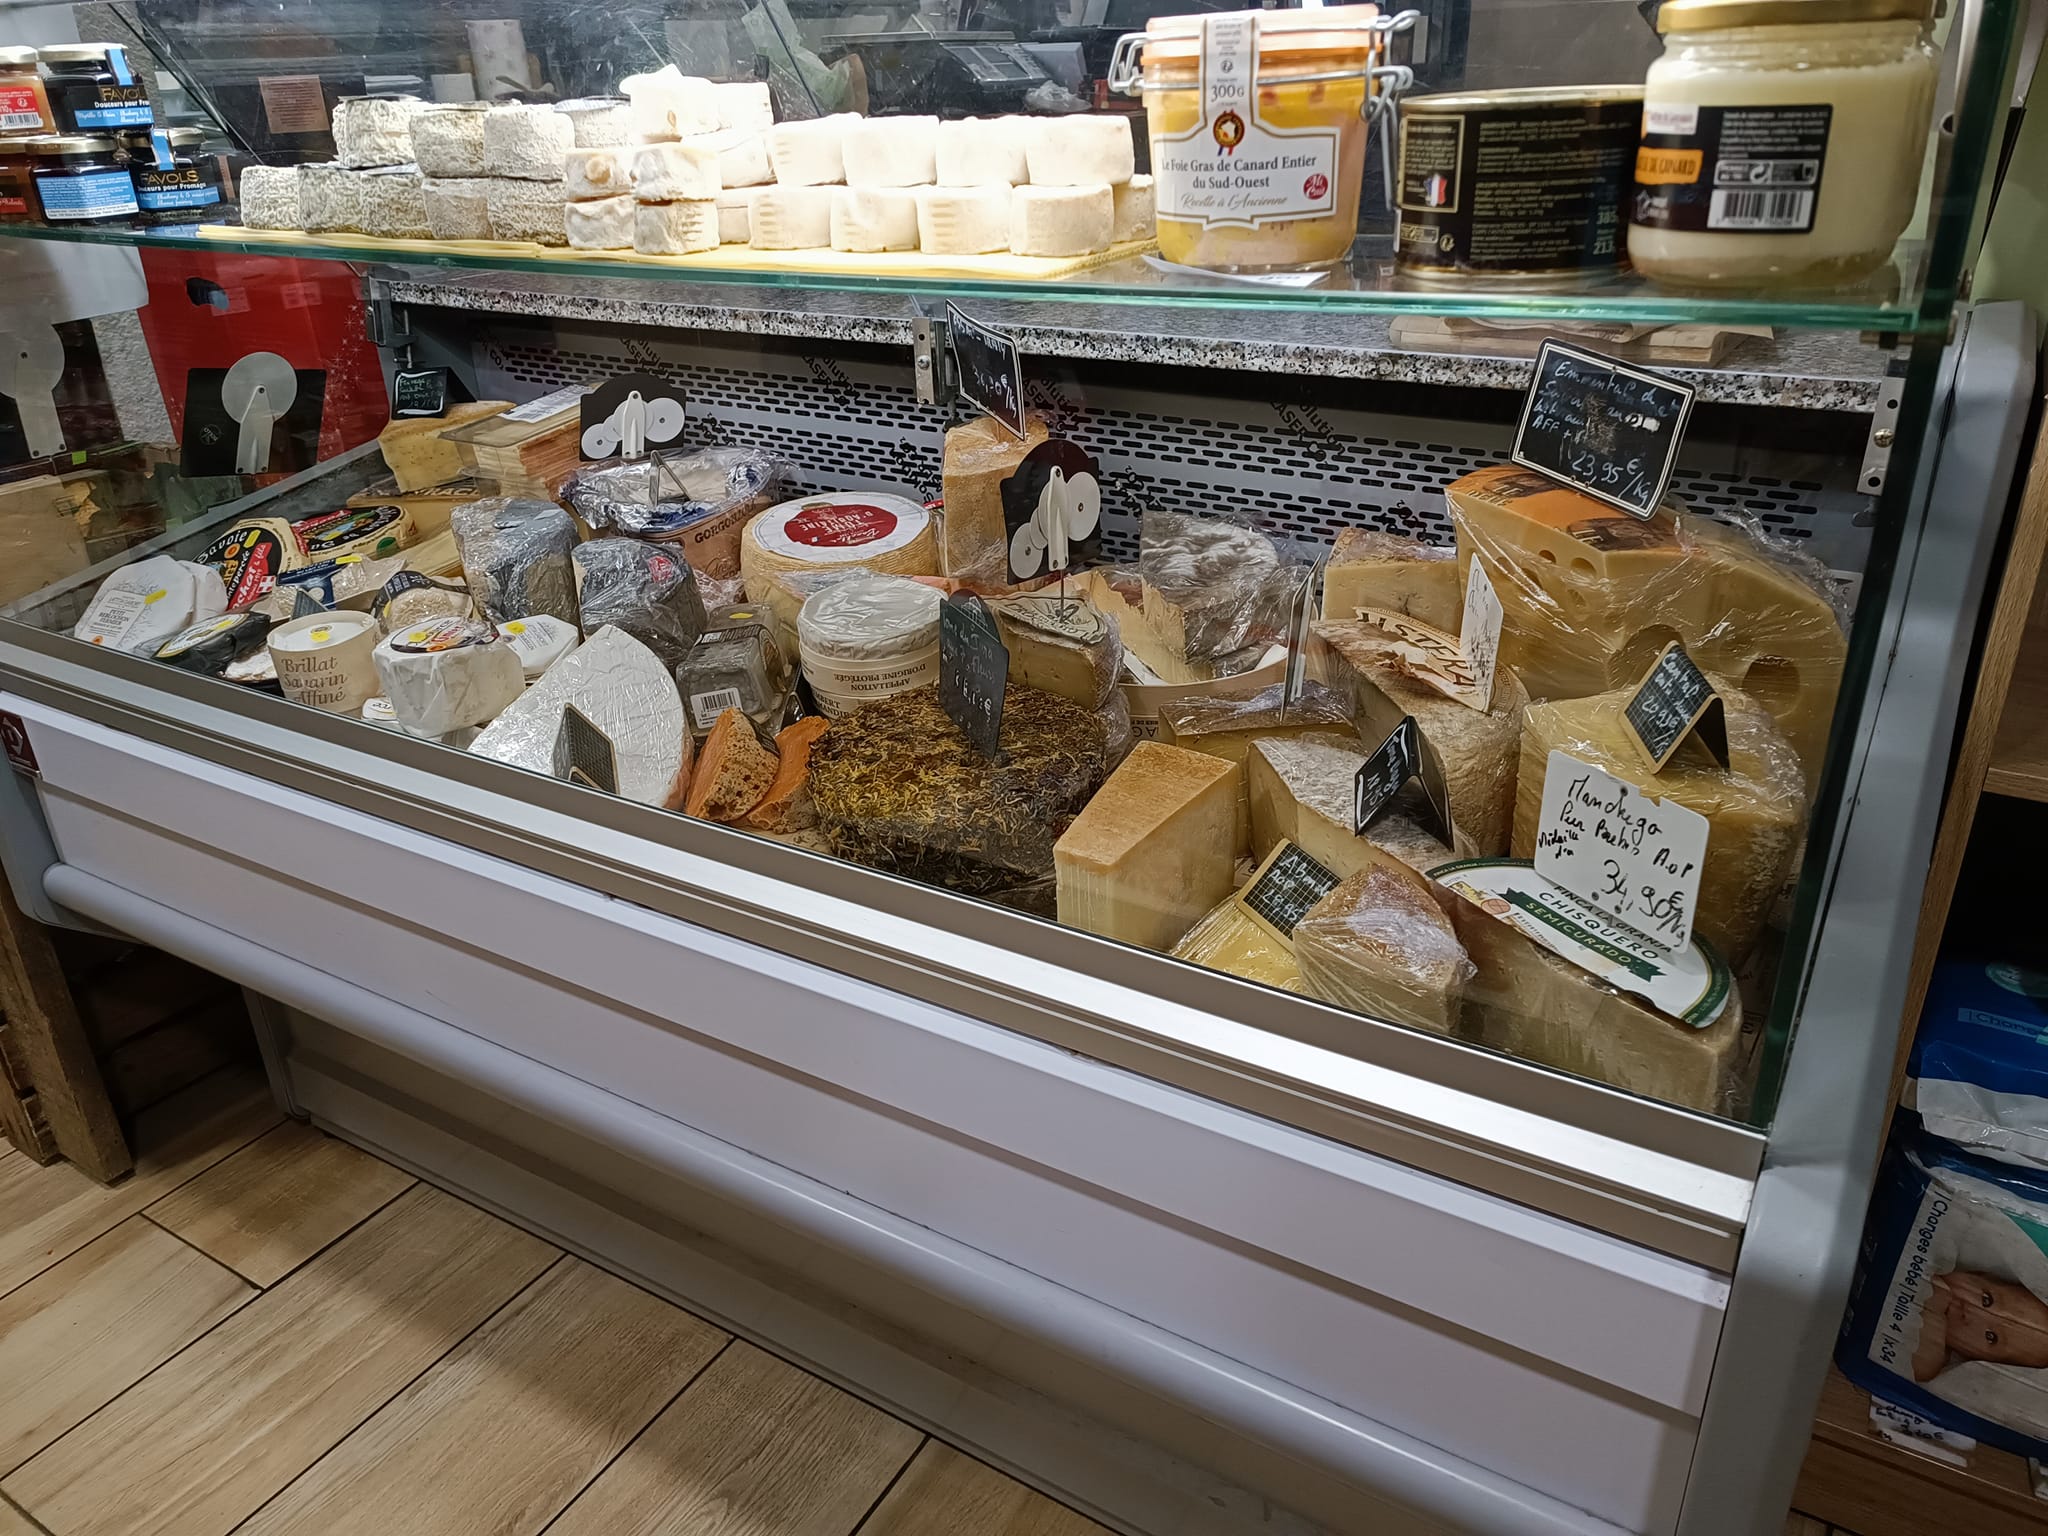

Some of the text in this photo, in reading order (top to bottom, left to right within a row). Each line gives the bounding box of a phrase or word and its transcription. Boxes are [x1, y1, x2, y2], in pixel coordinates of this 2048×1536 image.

[1171, 159, 1188, 171] Foie
[1190, 159, 1214, 172] Gras
[1217, 159, 1231, 172] de
[1234, 156, 1278, 172] Canard
[1281, 154, 1317, 169] Entier
[1192, 175, 1270, 190] du Sud-Ouest
[281, 656, 338, 673] Brillat
[882, 662, 927, 680] D'ORIGINE
[284, 671, 348, 689] Savarin
[850, 676, 912, 693] APPELLATION
[294, 686, 346, 706] Affiné
[1538, 891, 1660, 960] CHISQUERO
[1553, 884, 1672, 954] FINCA LA GRANJA
[1525, 900, 1633, 964] SEMICURADO
[1879, 1200, 1949, 1365] Changes bébé Taille 4 x34
